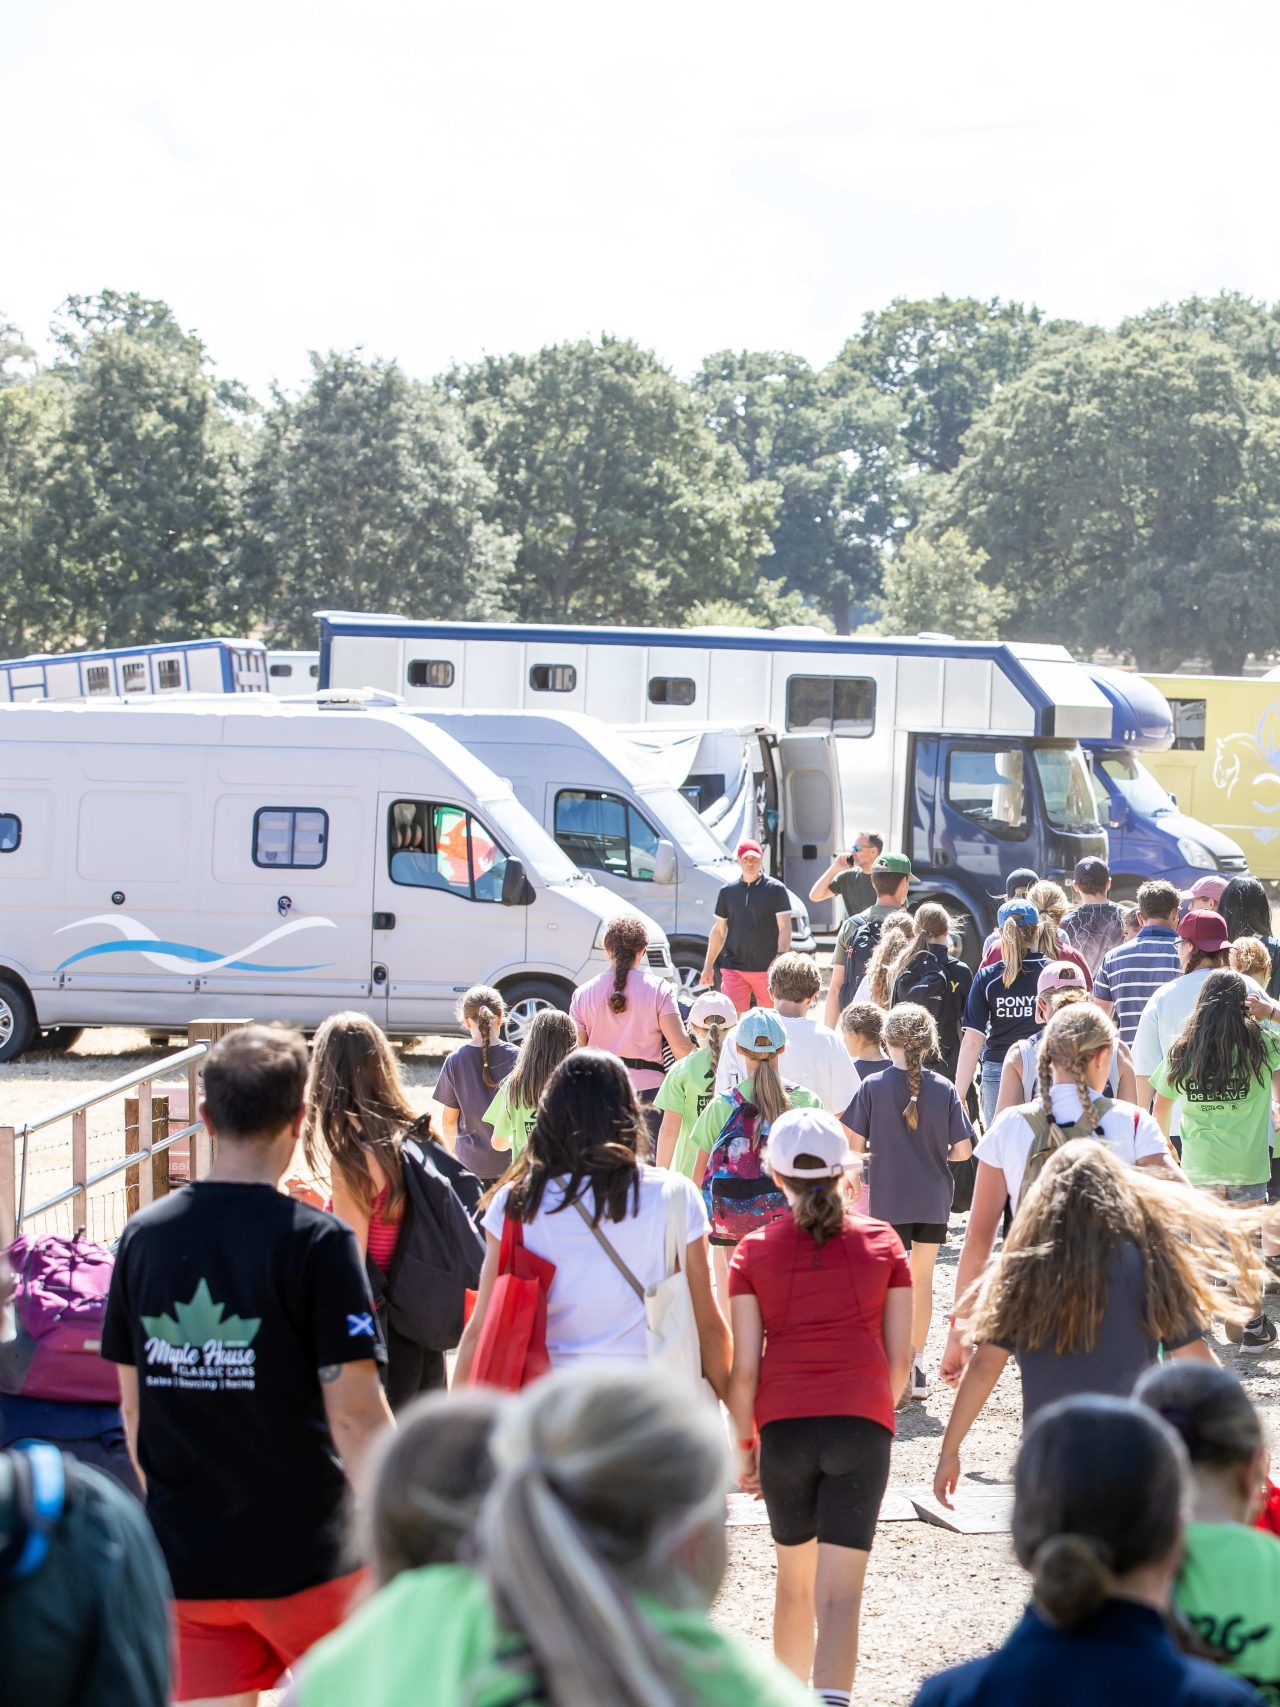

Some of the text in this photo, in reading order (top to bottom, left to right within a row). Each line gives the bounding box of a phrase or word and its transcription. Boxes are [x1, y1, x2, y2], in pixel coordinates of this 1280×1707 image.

[996, 995, 1035, 1008] PONY
[996, 1006, 1033, 1018] CLUB
[1190, 1090, 1204, 1101] be
[179, 1366, 256, 1378] CLASSIC CARS
